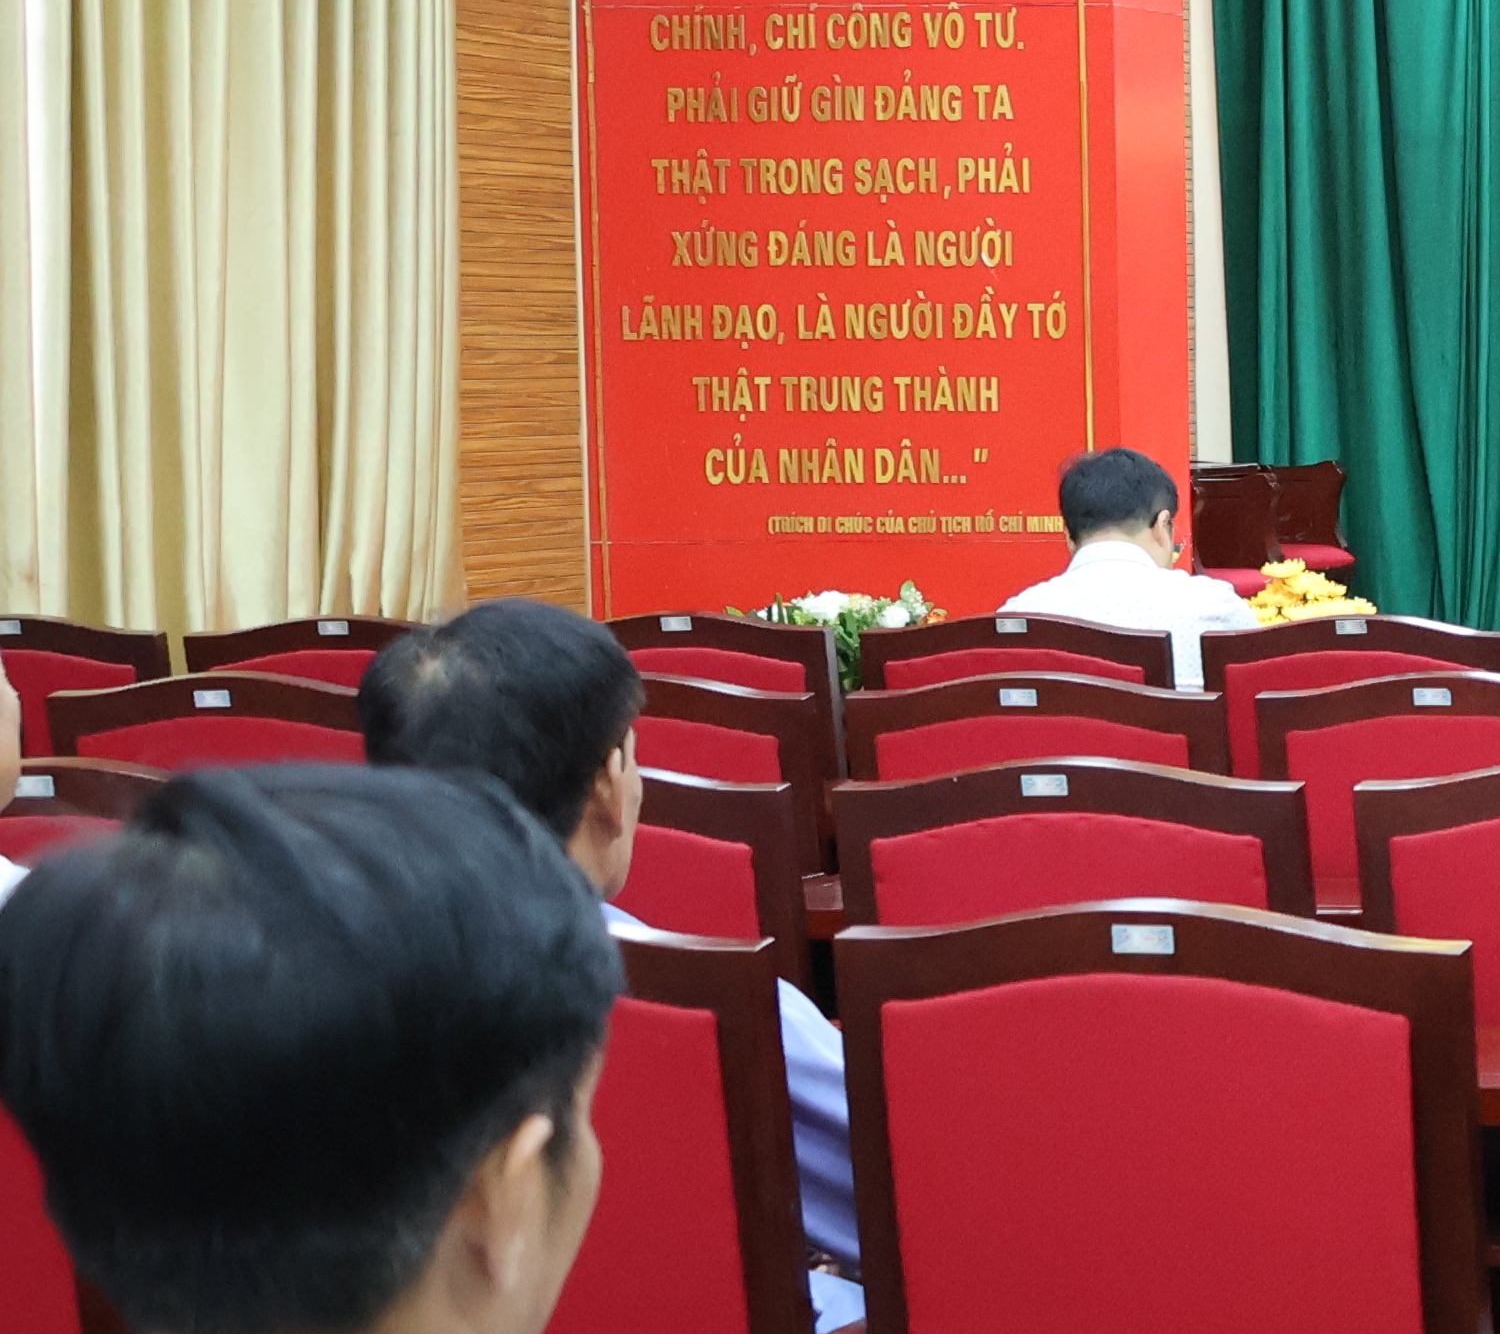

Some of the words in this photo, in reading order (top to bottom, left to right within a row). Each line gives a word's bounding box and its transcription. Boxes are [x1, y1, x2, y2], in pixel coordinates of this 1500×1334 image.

[651, 6, 756, 55] CHÍNH,
[766, 3, 817, 49] CHÍ
[827, 3, 912, 49] CÔNG
[923, 2, 965, 48] VÔ
[974, 7, 1024, 49] TƯ.
[668, 73, 737, 122] PHẢI
[749, 75, 802, 122] GIỮ
[812, 75, 864, 121] GÌN
[874, 69, 962, 121] ĐẢNG
[973, 85, 1014, 120] TA
[652, 149, 730, 203] THẬT
[740, 158, 843, 194] TRONG
[958, 142, 1030, 193] PHẢI
[672, 220, 758, 267] XỨNG
[768, 220, 856, 266] ĐÁNG
[868, 220, 905, 266] LÀ
[916, 218, 1012, 267] NGƯỜI
[623, 296, 702, 340] LÃNH
[713, 304, 784, 349] ĐẠO,
[798, 293, 836, 339] LÀ
[845, 291, 943, 339] NGƯỜI
[953, 286, 1018, 338] ĐẦY
[1027, 291, 1066, 339] TỚ
[693, 368, 771, 421] THẬT
[781, 376, 883, 412] TRUNG
[894, 366, 998, 411] THÀNH
[706, 433, 769, 485] CỦA
[779, 438, 864, 483] NHÂN
